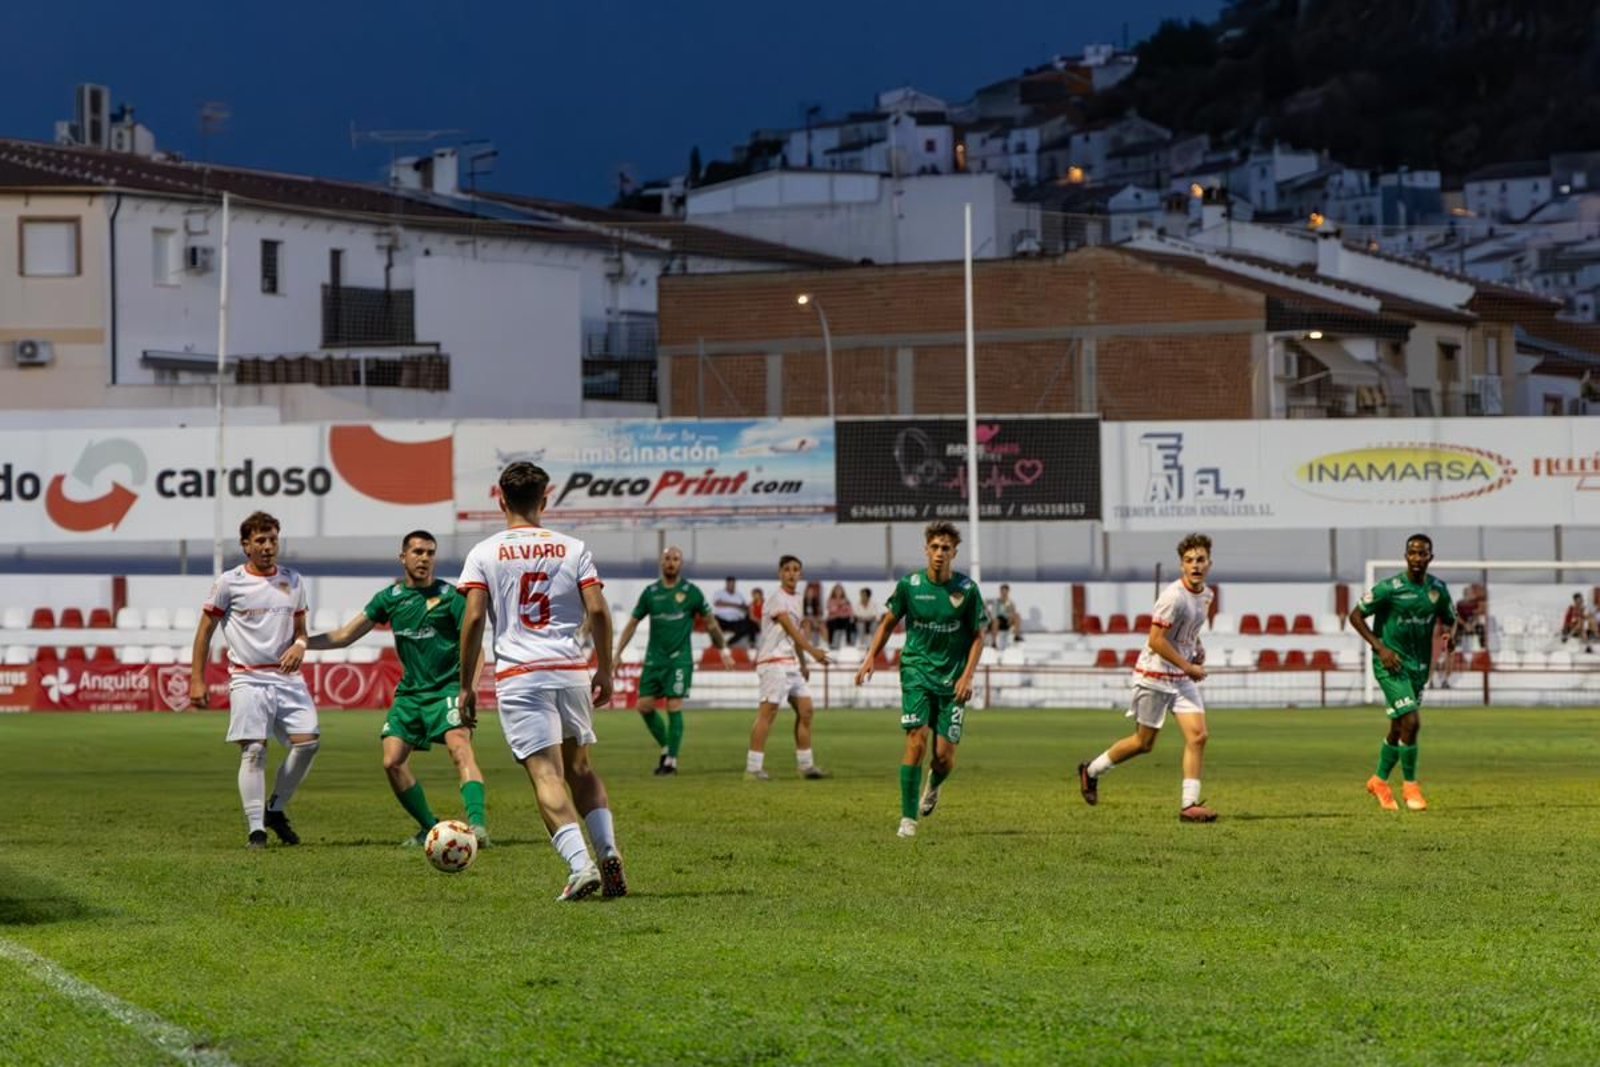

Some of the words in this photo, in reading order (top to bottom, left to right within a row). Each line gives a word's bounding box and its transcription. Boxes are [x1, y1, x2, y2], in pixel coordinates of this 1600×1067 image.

[155, 459, 333, 498] cardoso
[1307, 461, 1490, 483] INAMARSA
[498, 543, 566, 561] ÁLVARO
[519, 571, 551, 630] 5
